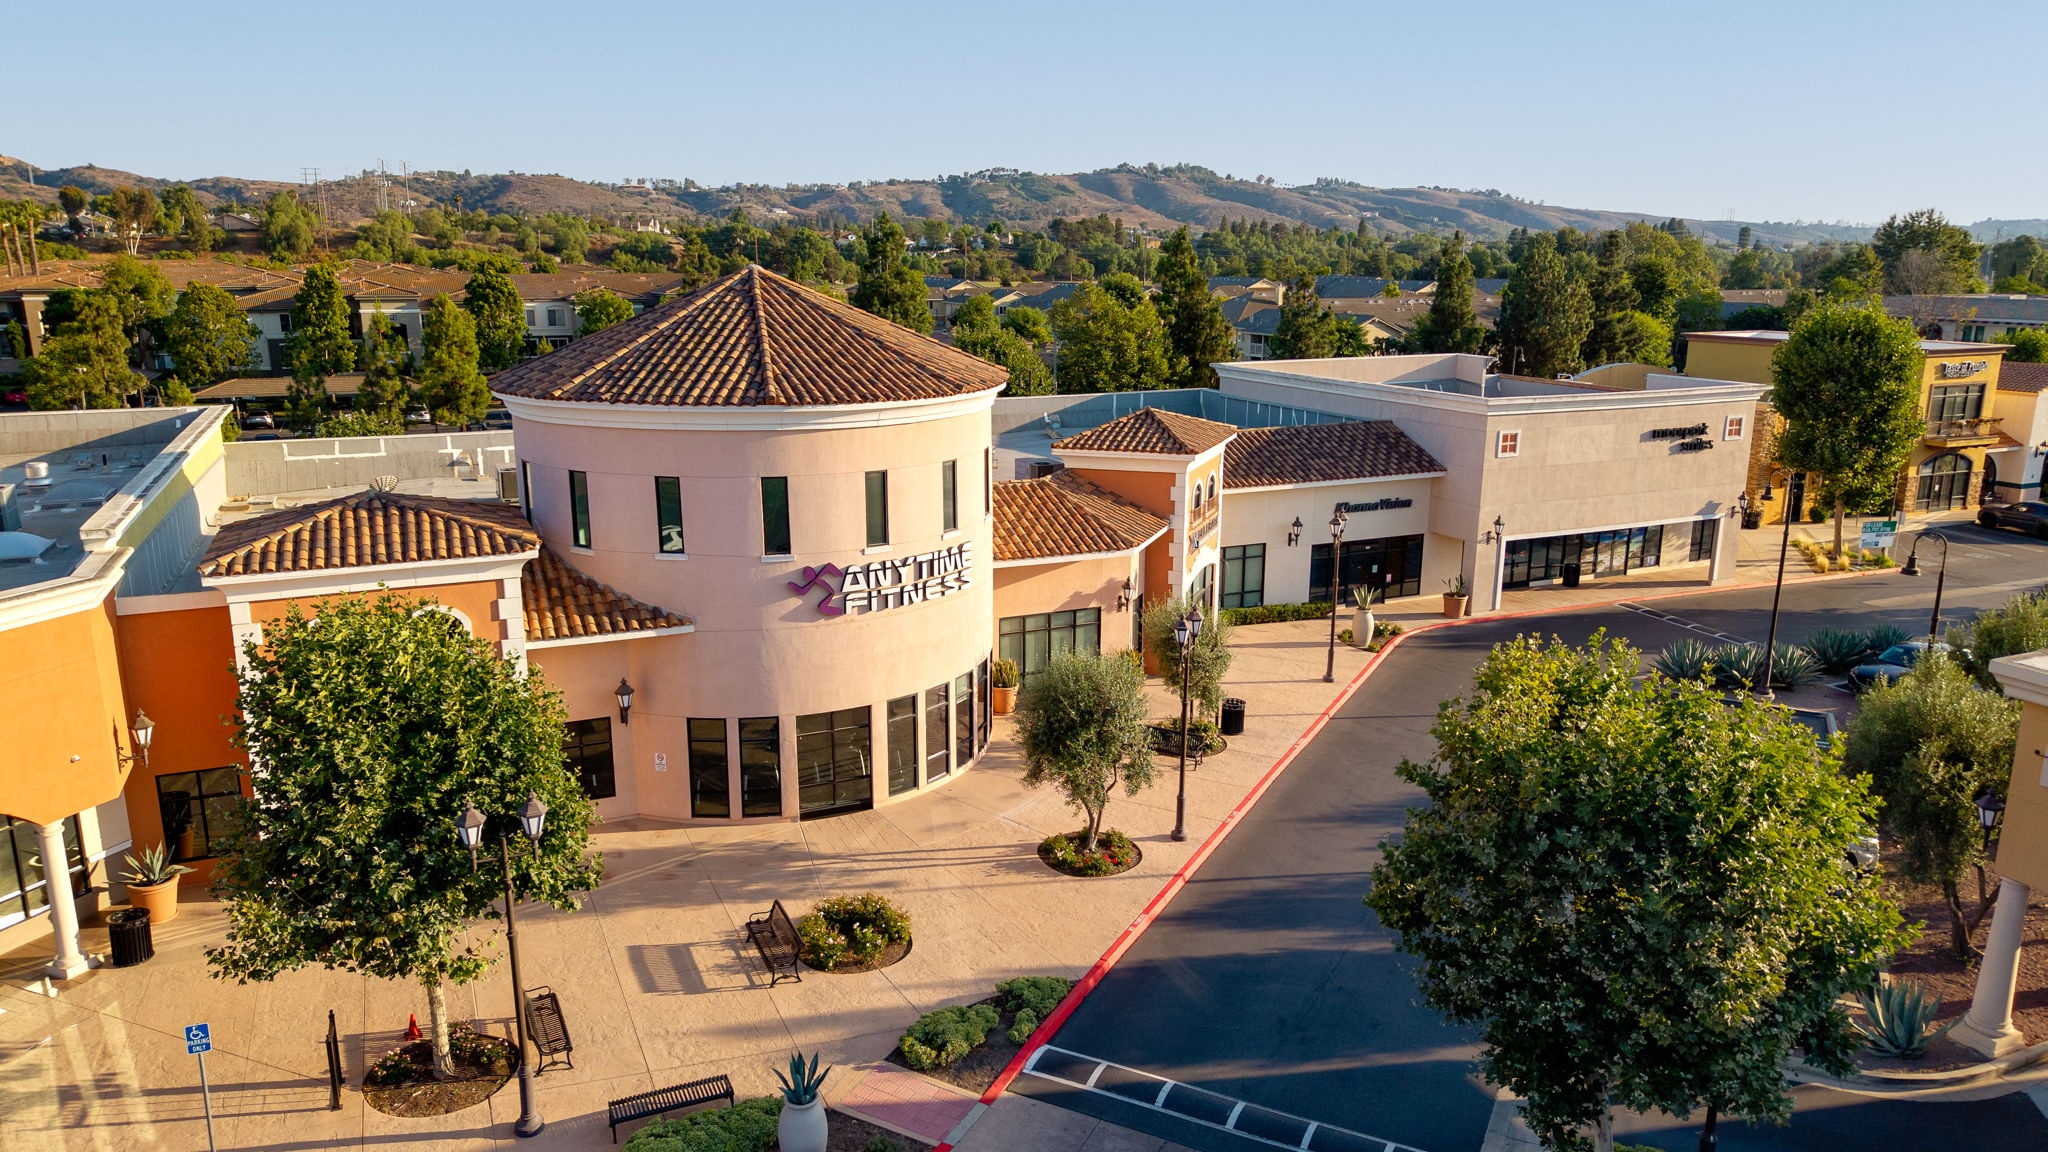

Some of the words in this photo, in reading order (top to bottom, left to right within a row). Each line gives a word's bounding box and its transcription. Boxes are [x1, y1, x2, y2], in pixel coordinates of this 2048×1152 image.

[841, 541, 973, 593] ANYTIME
[845, 567, 973, 615] FITNESS
[187, 1037, 210, 1046] PARKING
